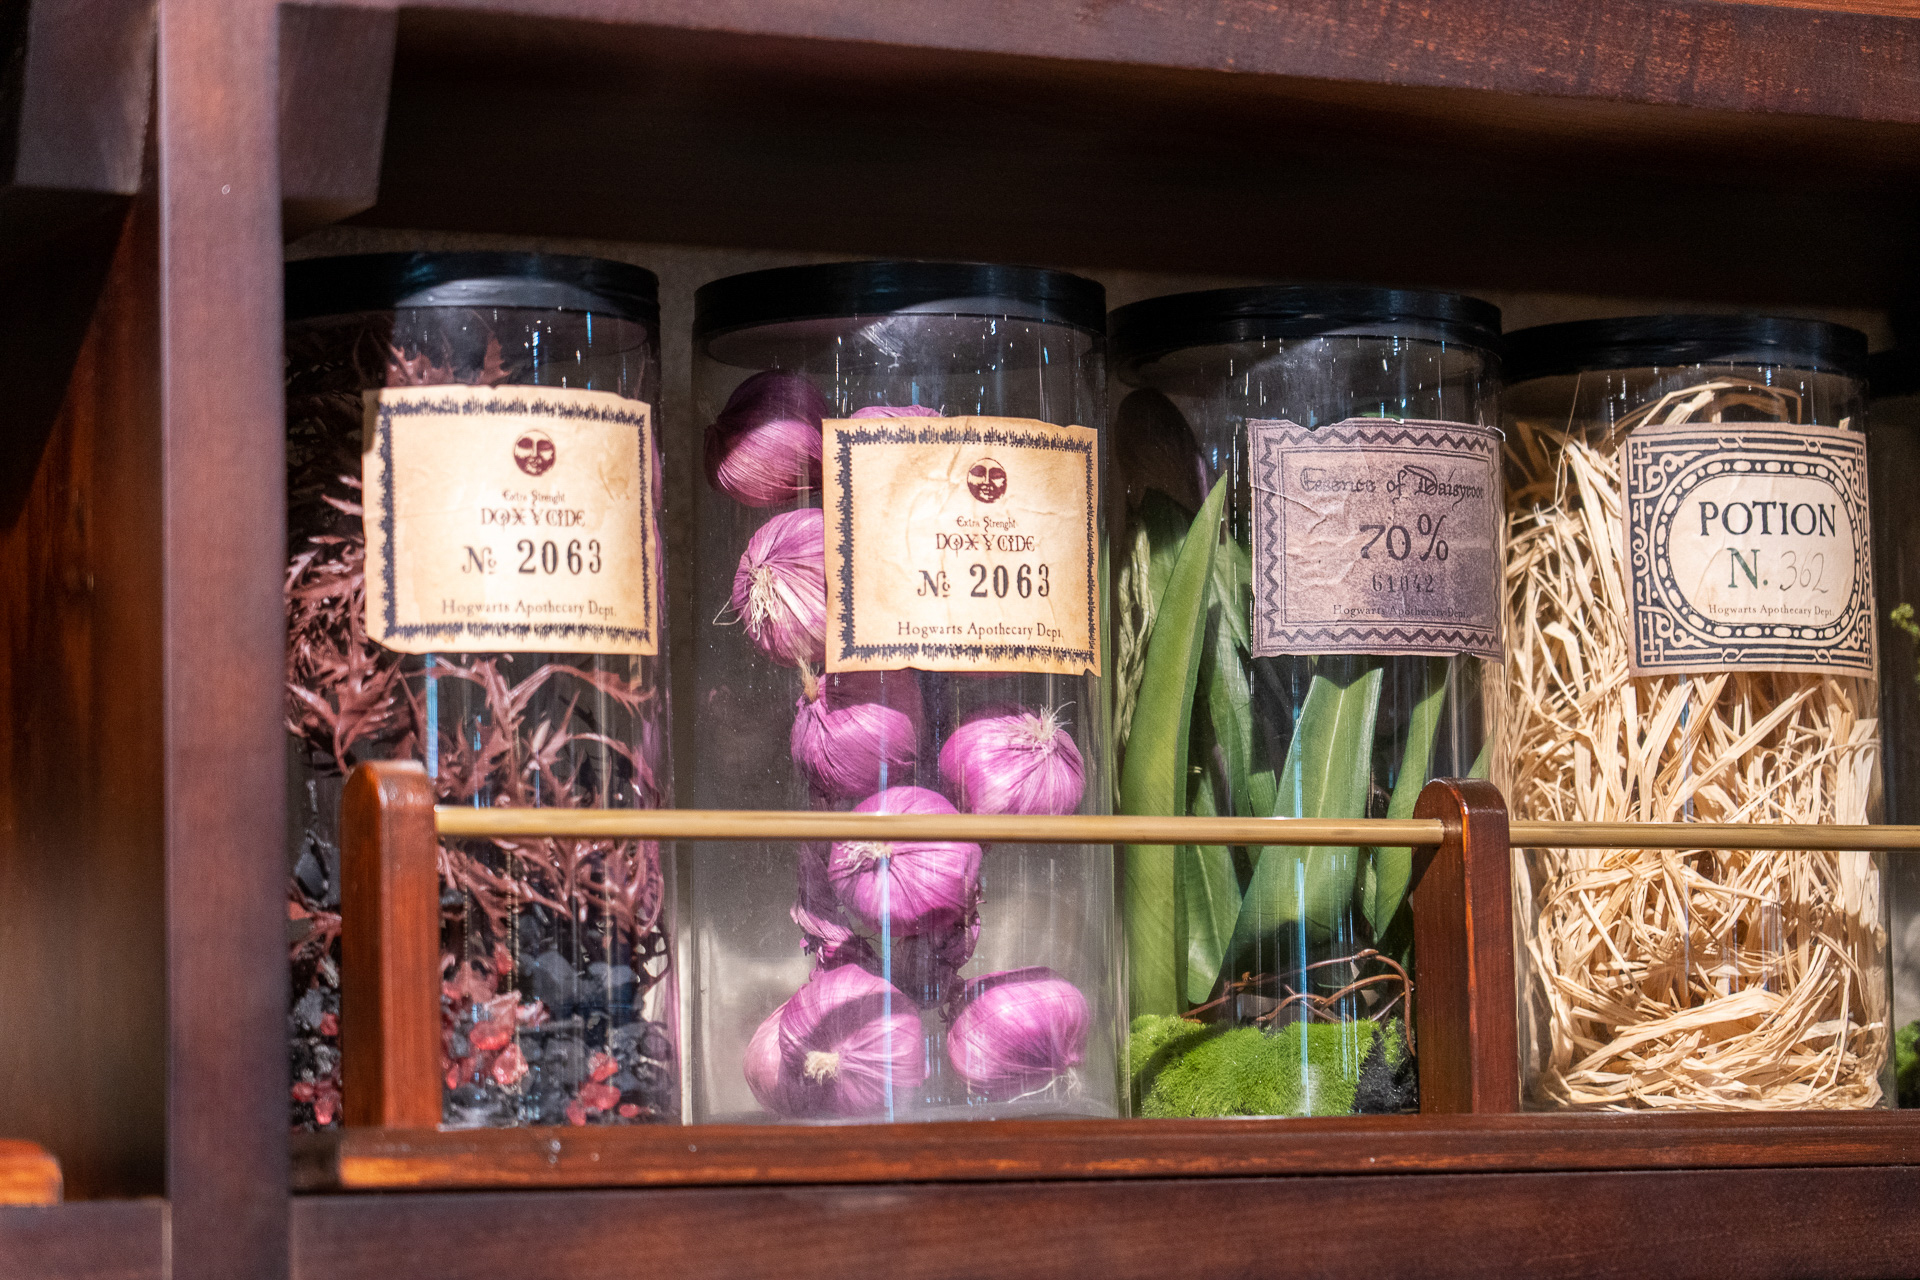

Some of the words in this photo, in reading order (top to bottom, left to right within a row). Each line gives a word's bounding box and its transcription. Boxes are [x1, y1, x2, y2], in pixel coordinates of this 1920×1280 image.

[502, 489, 527, 501] Extra
[1386, 470, 1411, 504] of
[481, 507, 585, 530] DOXYCIDE
[956, 516, 980, 528] Extra
[983, 516, 1016, 533] Strenght
[1698, 501, 1836, 537] POTION
[936, 533, 1036, 557] DOXYCIDE
[1359, 513, 1449, 561] 70%
[517, 539, 602, 575] 2063
[969, 563, 1050, 598] 2063
[1727, 547, 1768, 589] N.
[1779, 550, 1829, 594] 362
[1372, 574, 1434, 593] 61042
[442, 600, 510, 617] Hogwarts
[515, 601, 585, 617] Apothecary
[588, 601, 617, 620] Dept.
[1333, 605, 1385, 618] Hogwarts
[1389, 606, 1445, 619] Apothecary
[1446, 607, 1469, 621] Dept.
[1708, 604, 1757, 616] Hogwarts
[1760, 605, 1811, 618] Apothecary
[1814, 606, 1835, 617] Dept.
[897, 622, 963, 638] Hogwarts
[967, 623, 1033, 640] Apothecary
[1037, 623, 1064, 641] Dept.
